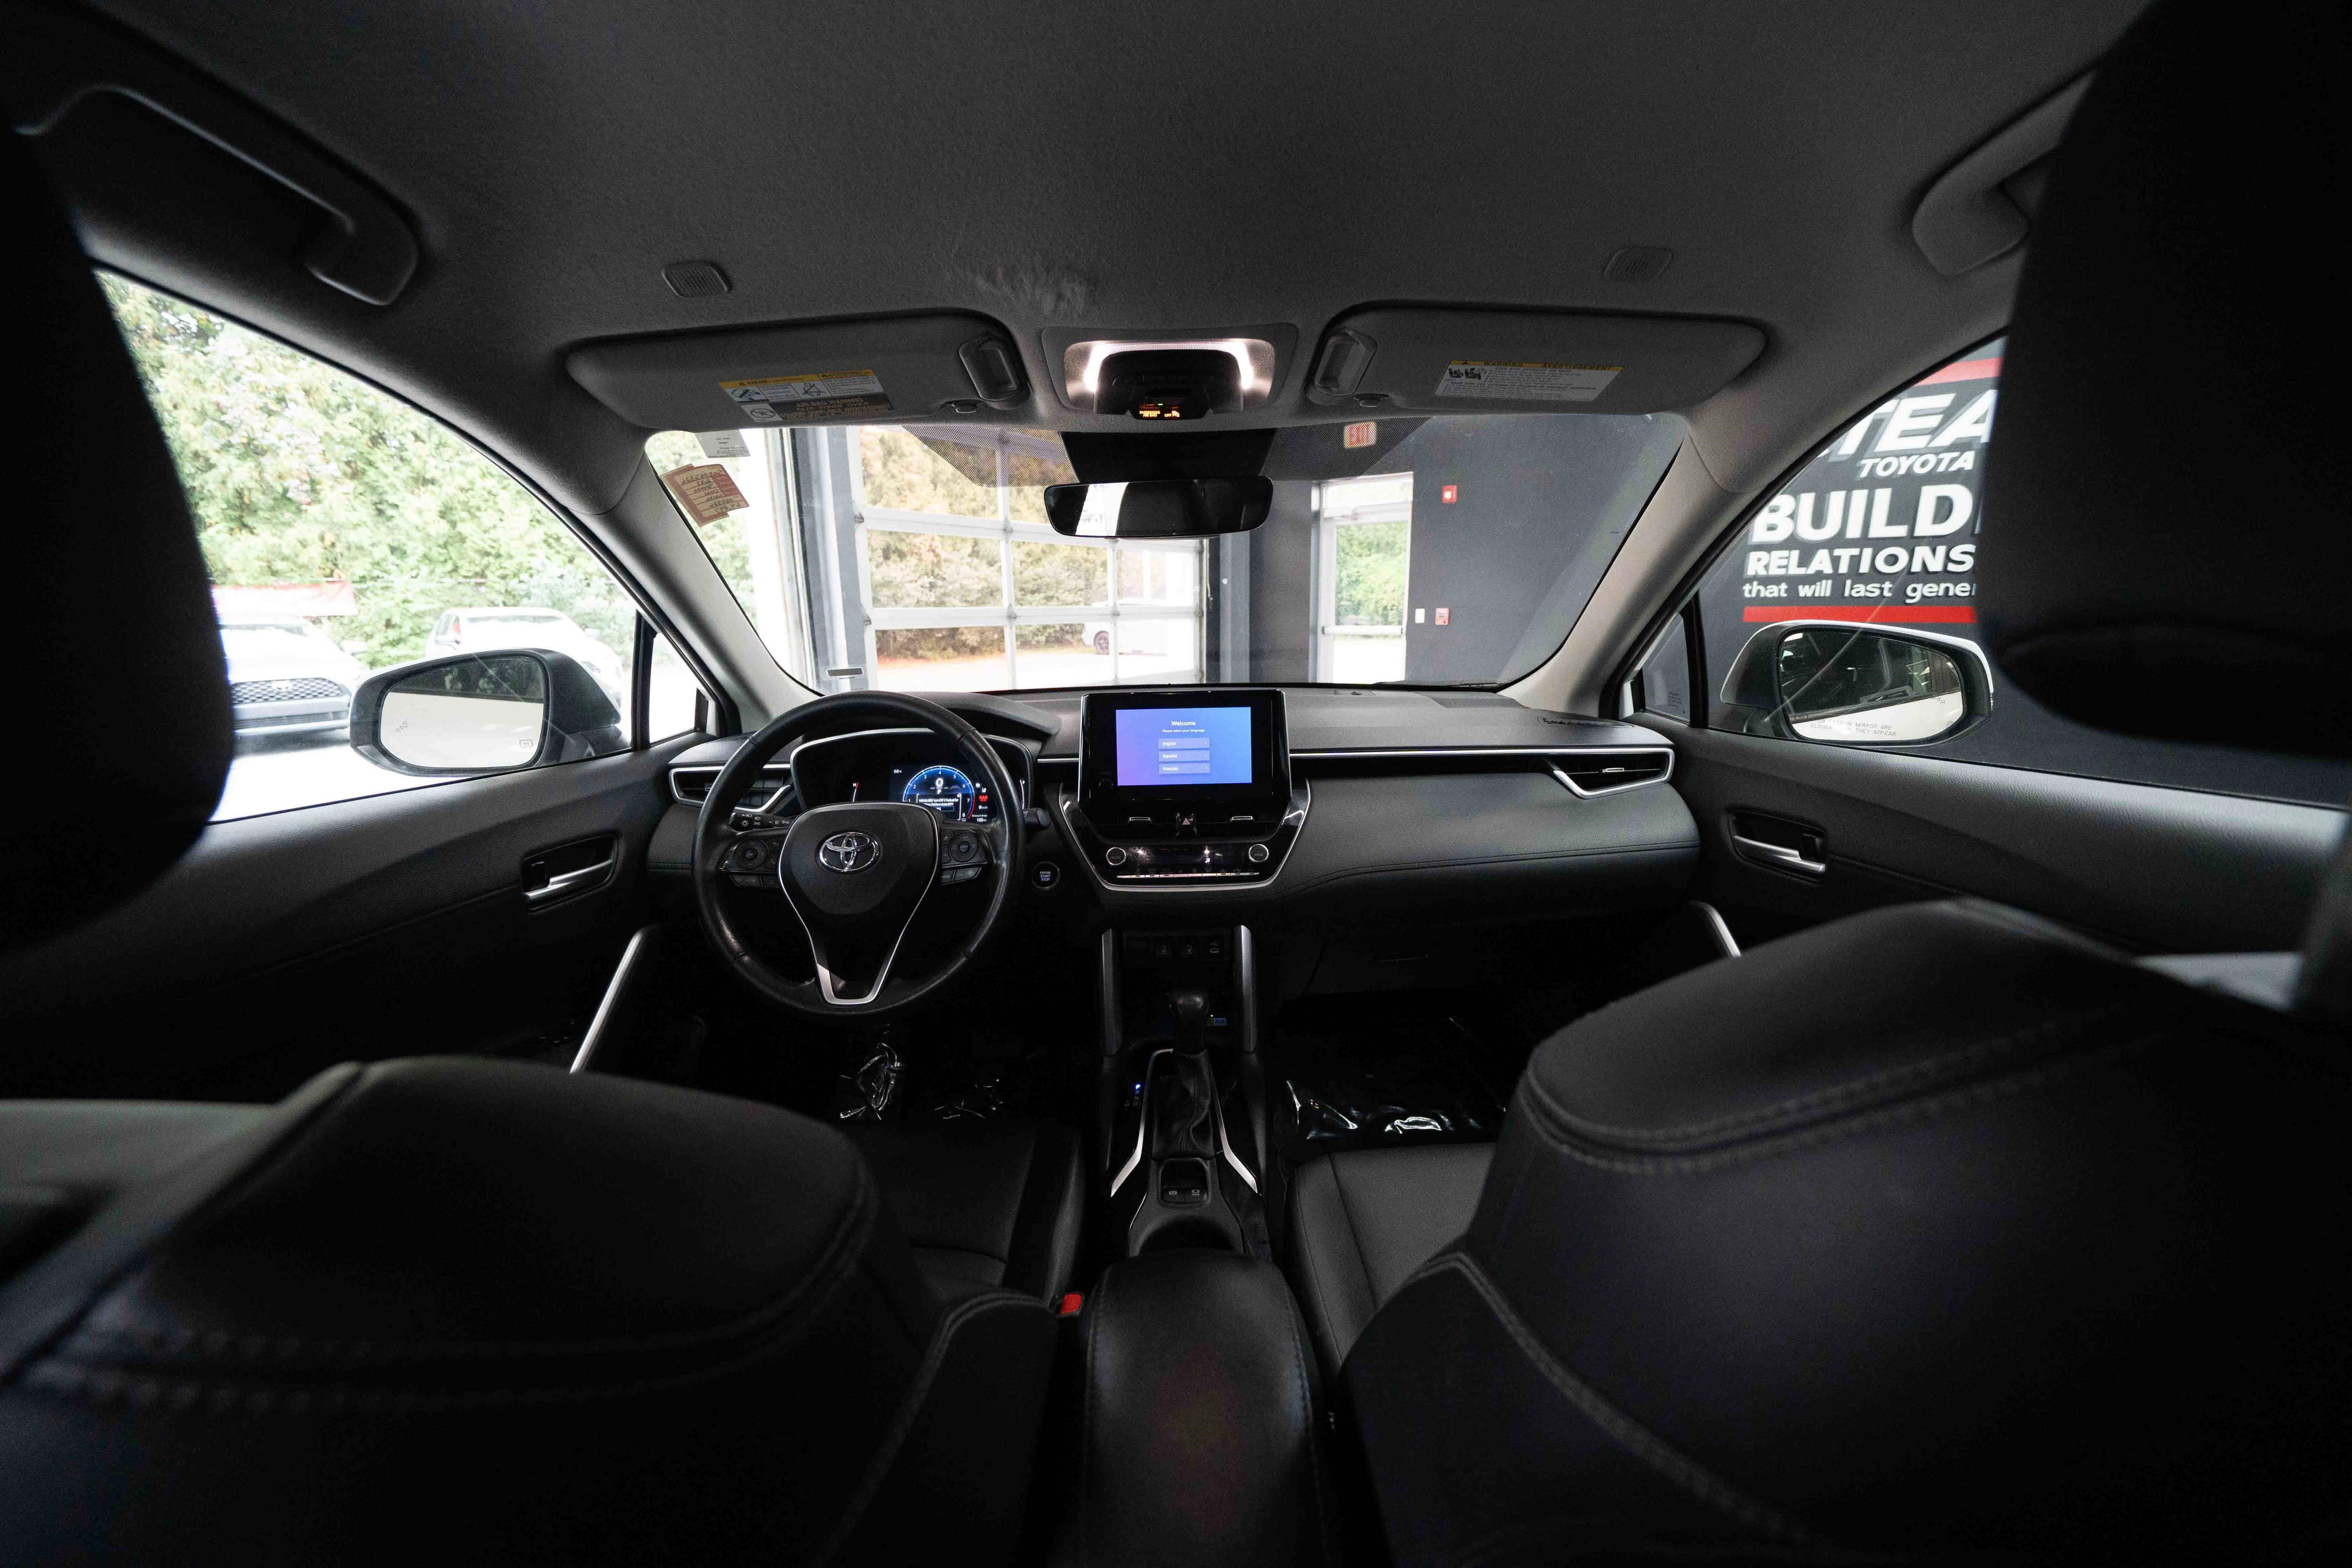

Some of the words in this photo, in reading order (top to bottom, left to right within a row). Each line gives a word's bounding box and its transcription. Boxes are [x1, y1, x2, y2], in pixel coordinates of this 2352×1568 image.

[1859, 451, 1975, 478] TOYOTA
[1752, 484, 1980, 543] BUILD
[1747, 544, 1976, 576] RELATIONS
[1742, 581, 1787, 597] that
[1798, 580, 1831, 596] will
[1844, 579, 1892, 597] last
[935, 778, 943, 787] 0
